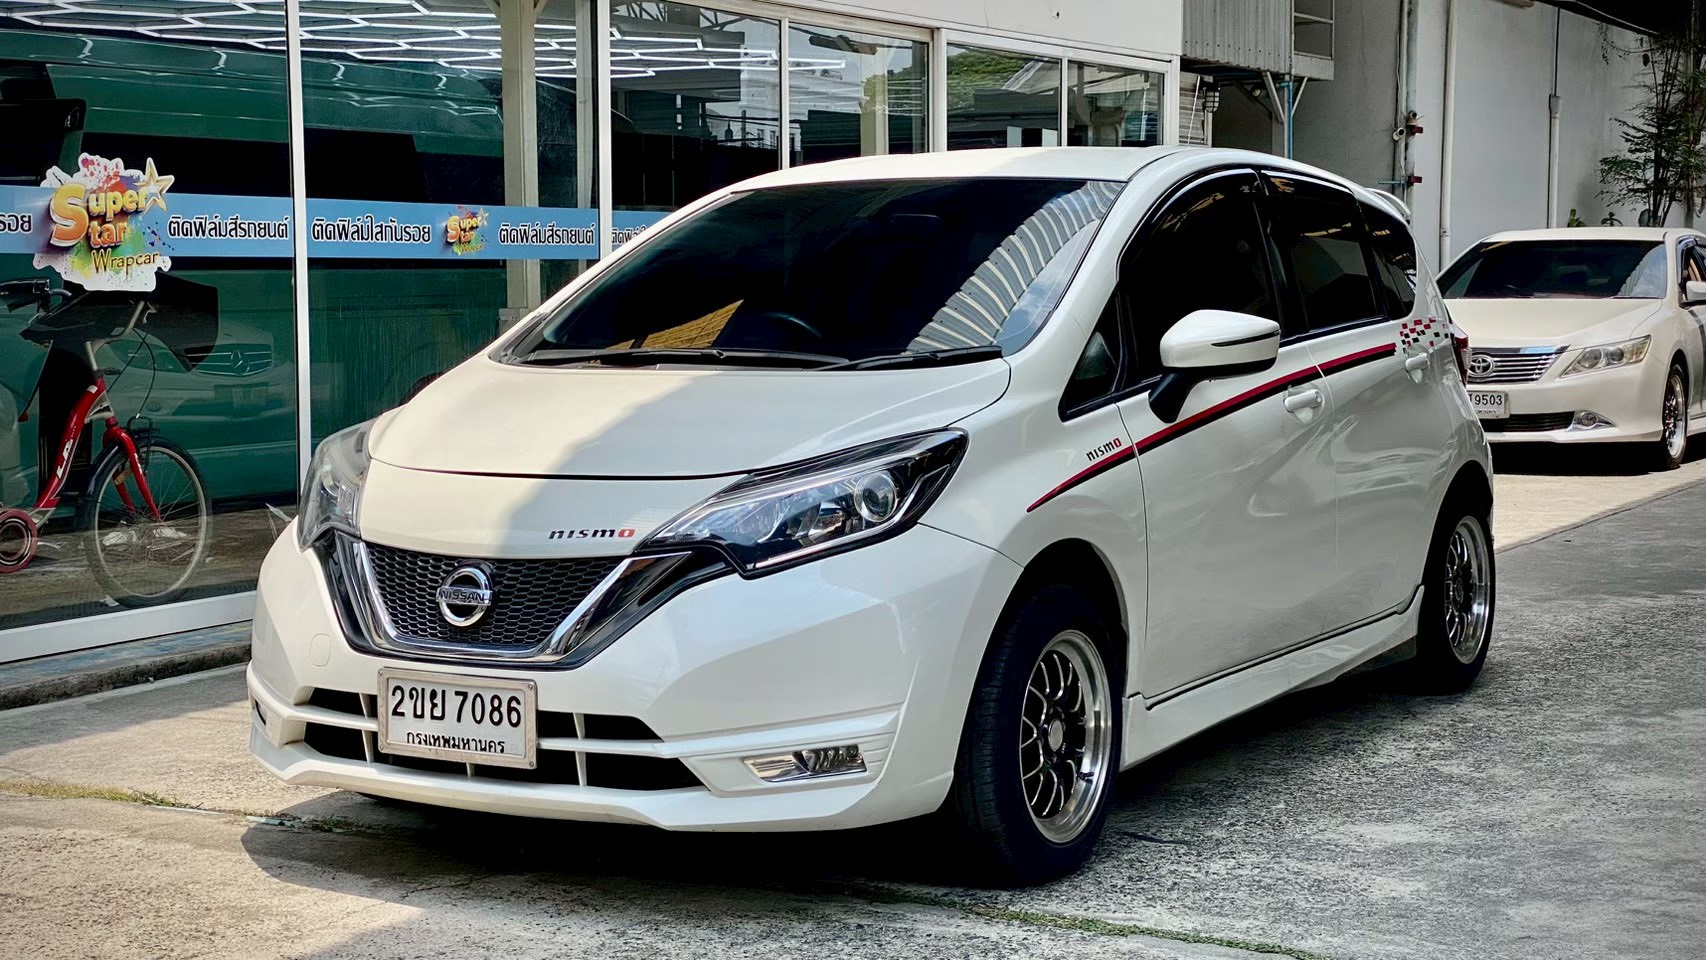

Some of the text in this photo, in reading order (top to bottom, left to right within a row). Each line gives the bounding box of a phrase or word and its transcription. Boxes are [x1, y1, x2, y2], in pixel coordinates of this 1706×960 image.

[168, 214, 289, 239] ติดฟิล์มสีรถยนต์
[312, 214, 432, 243] ติดฟิล์มใสกันรอย
[499, 222, 596, 245] ติดฟิล์มสีรถยนต์
[91, 248, 159, 276] Wrapcar
[1474, 394, 1503, 406] 9503
[440, 589, 485, 602] NISSAN
[391, 685, 521, 728] 2ขย 7086
[406, 732, 505, 753] กรงเทพมหานคร
